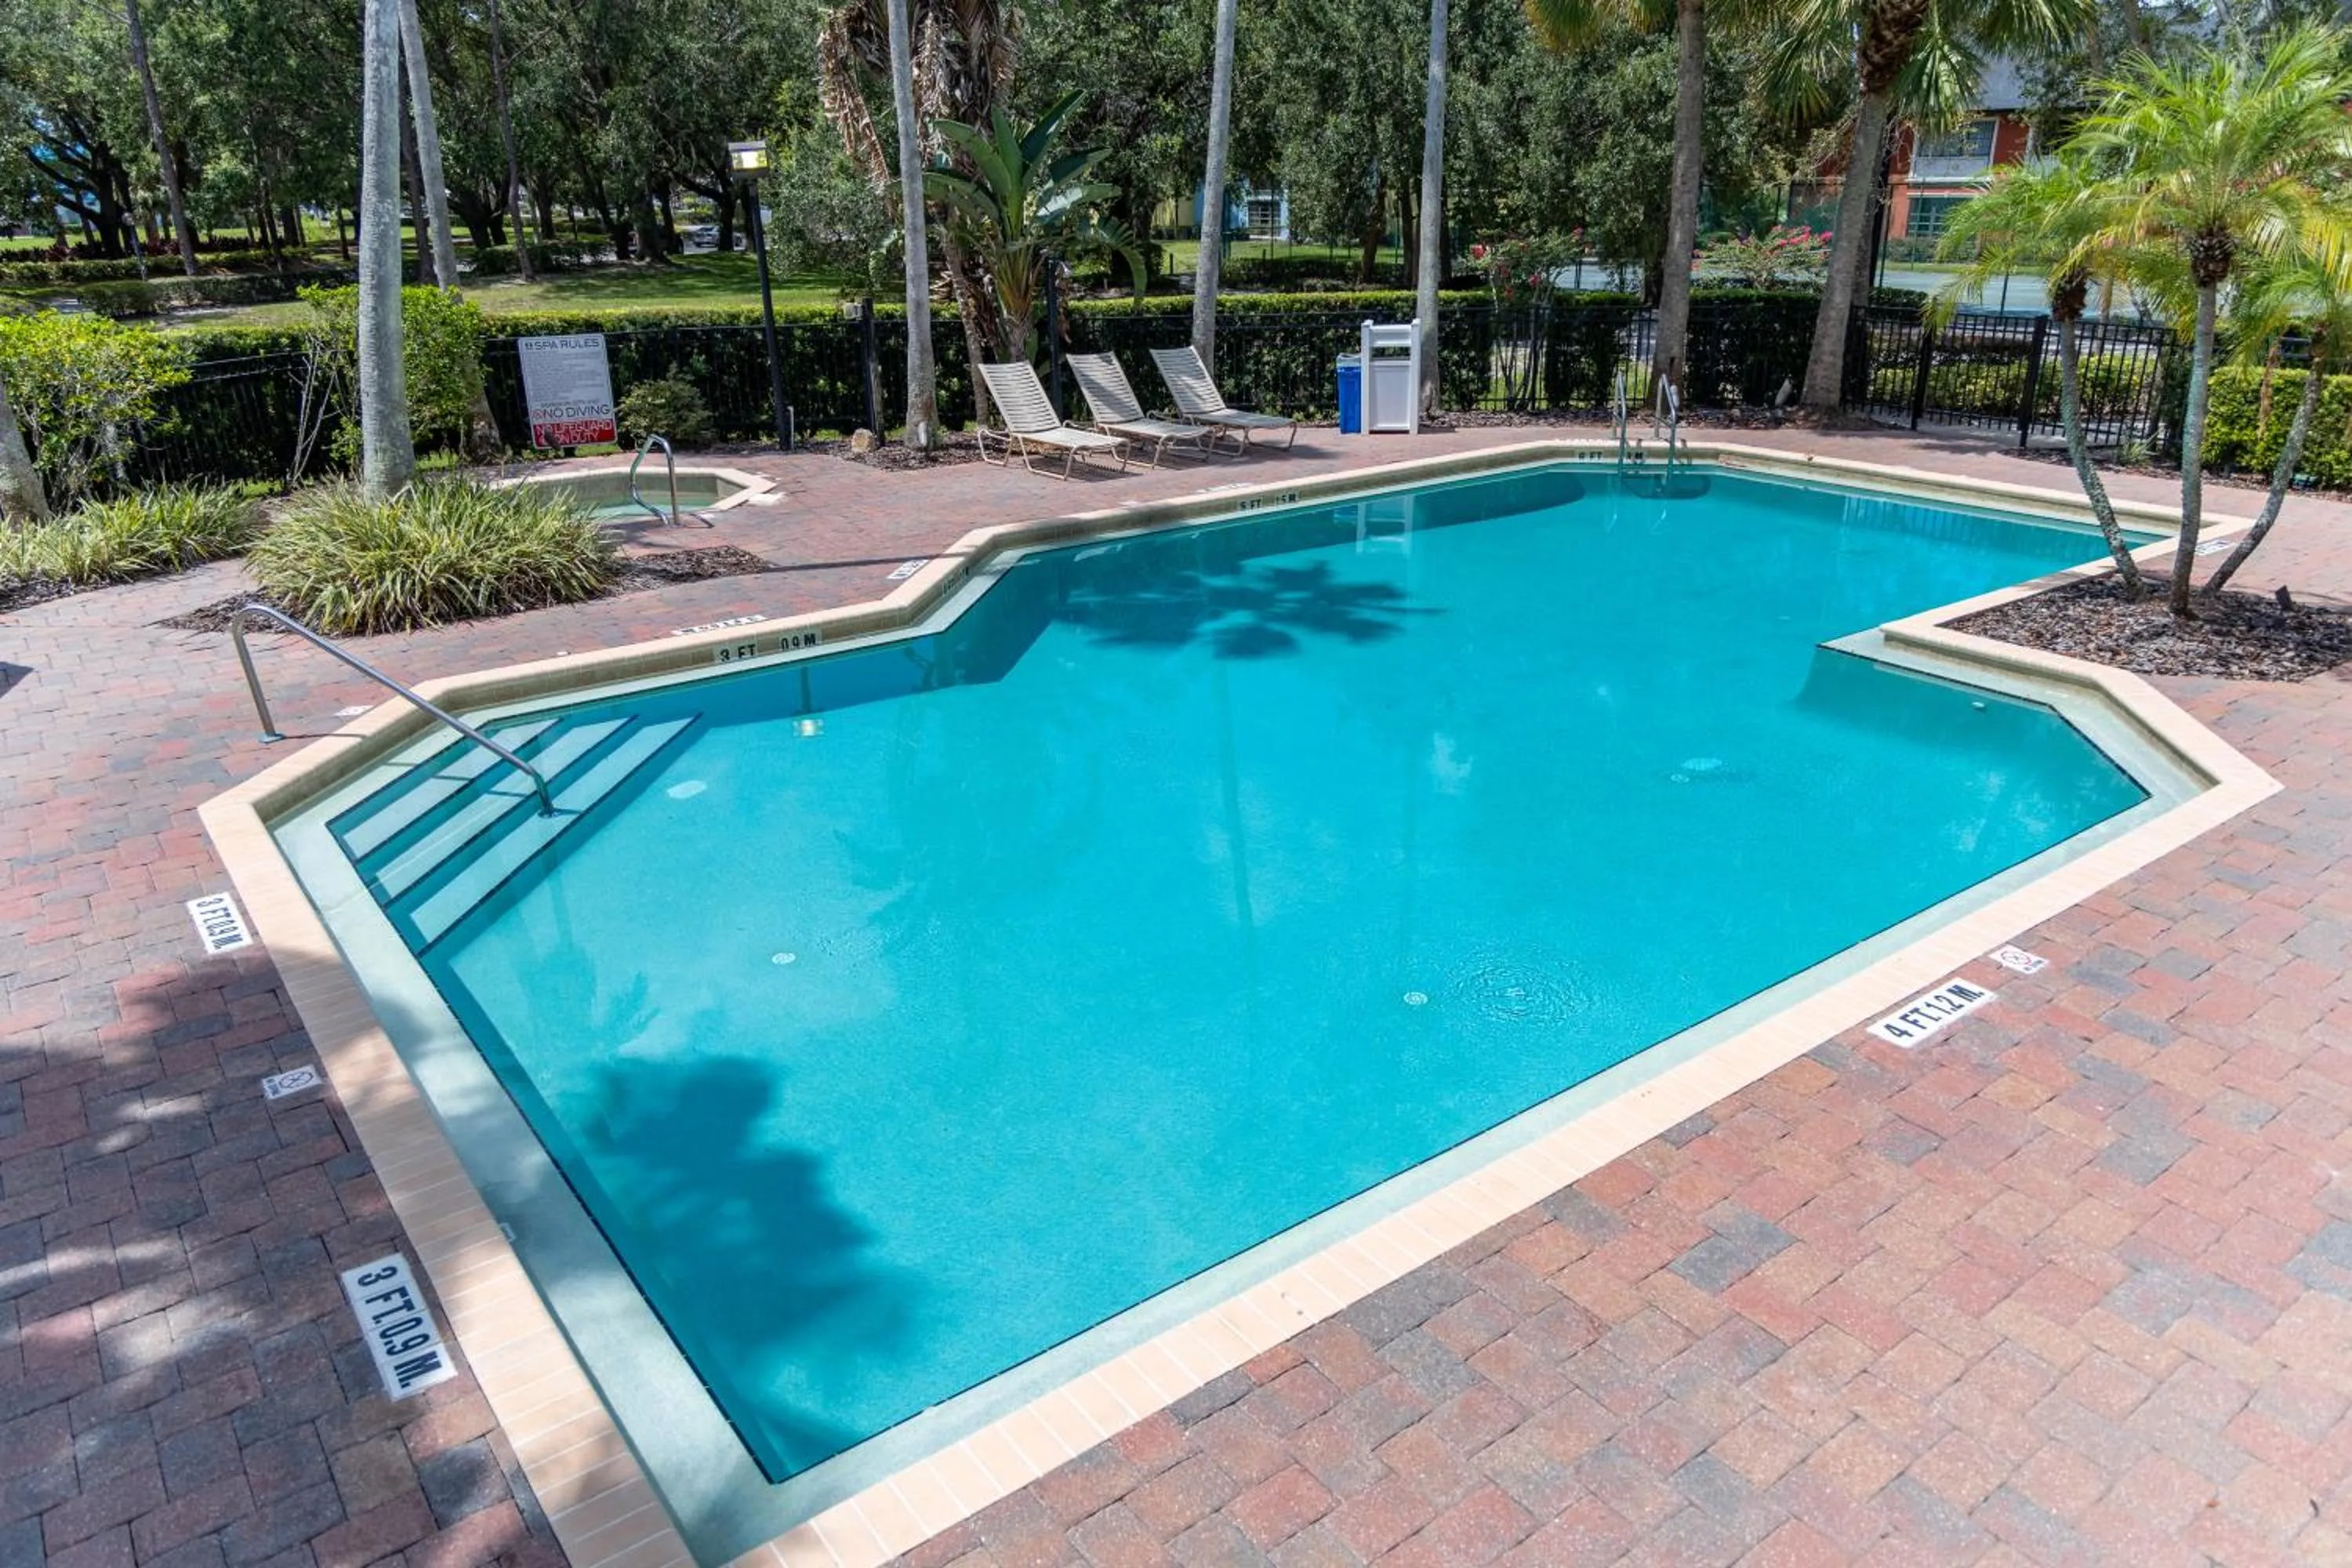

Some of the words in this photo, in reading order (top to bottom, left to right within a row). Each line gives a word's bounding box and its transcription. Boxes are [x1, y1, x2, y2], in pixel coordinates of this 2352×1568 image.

[534, 339, 559, 350] SPA
[559, 338, 600, 349] RULES
[543, 408, 564, 419] NO
[566, 404, 611, 417] DIVING
[720, 649, 730, 662] 3
[738, 644, 756, 659] FT
[1883, 1023, 1915, 1038] 4
[358, 1266, 398, 1287] 3
